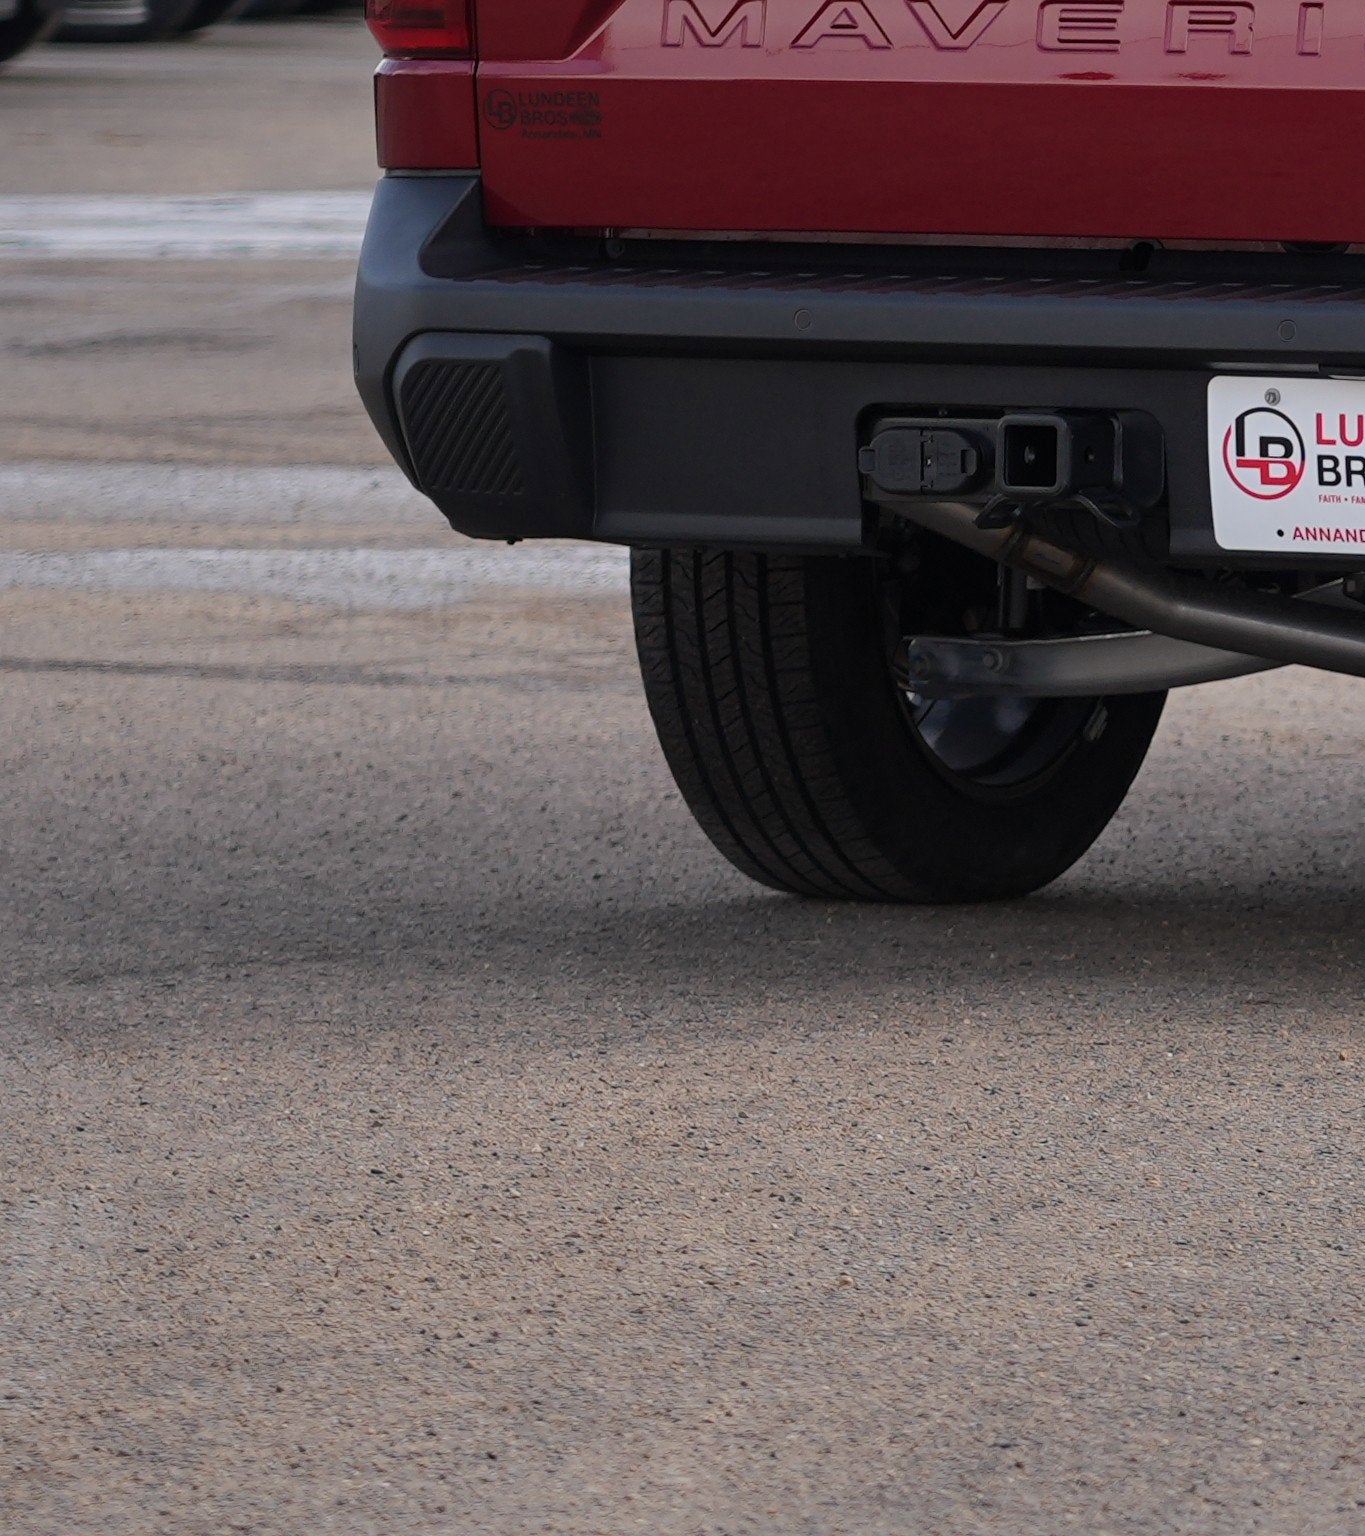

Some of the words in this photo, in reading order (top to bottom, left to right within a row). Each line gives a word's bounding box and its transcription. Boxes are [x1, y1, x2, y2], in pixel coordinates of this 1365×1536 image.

[518, 90, 600, 108] LUNDEEN
[519, 109, 569, 126] BROS
[1318, 494, 1342, 504] FAITH
